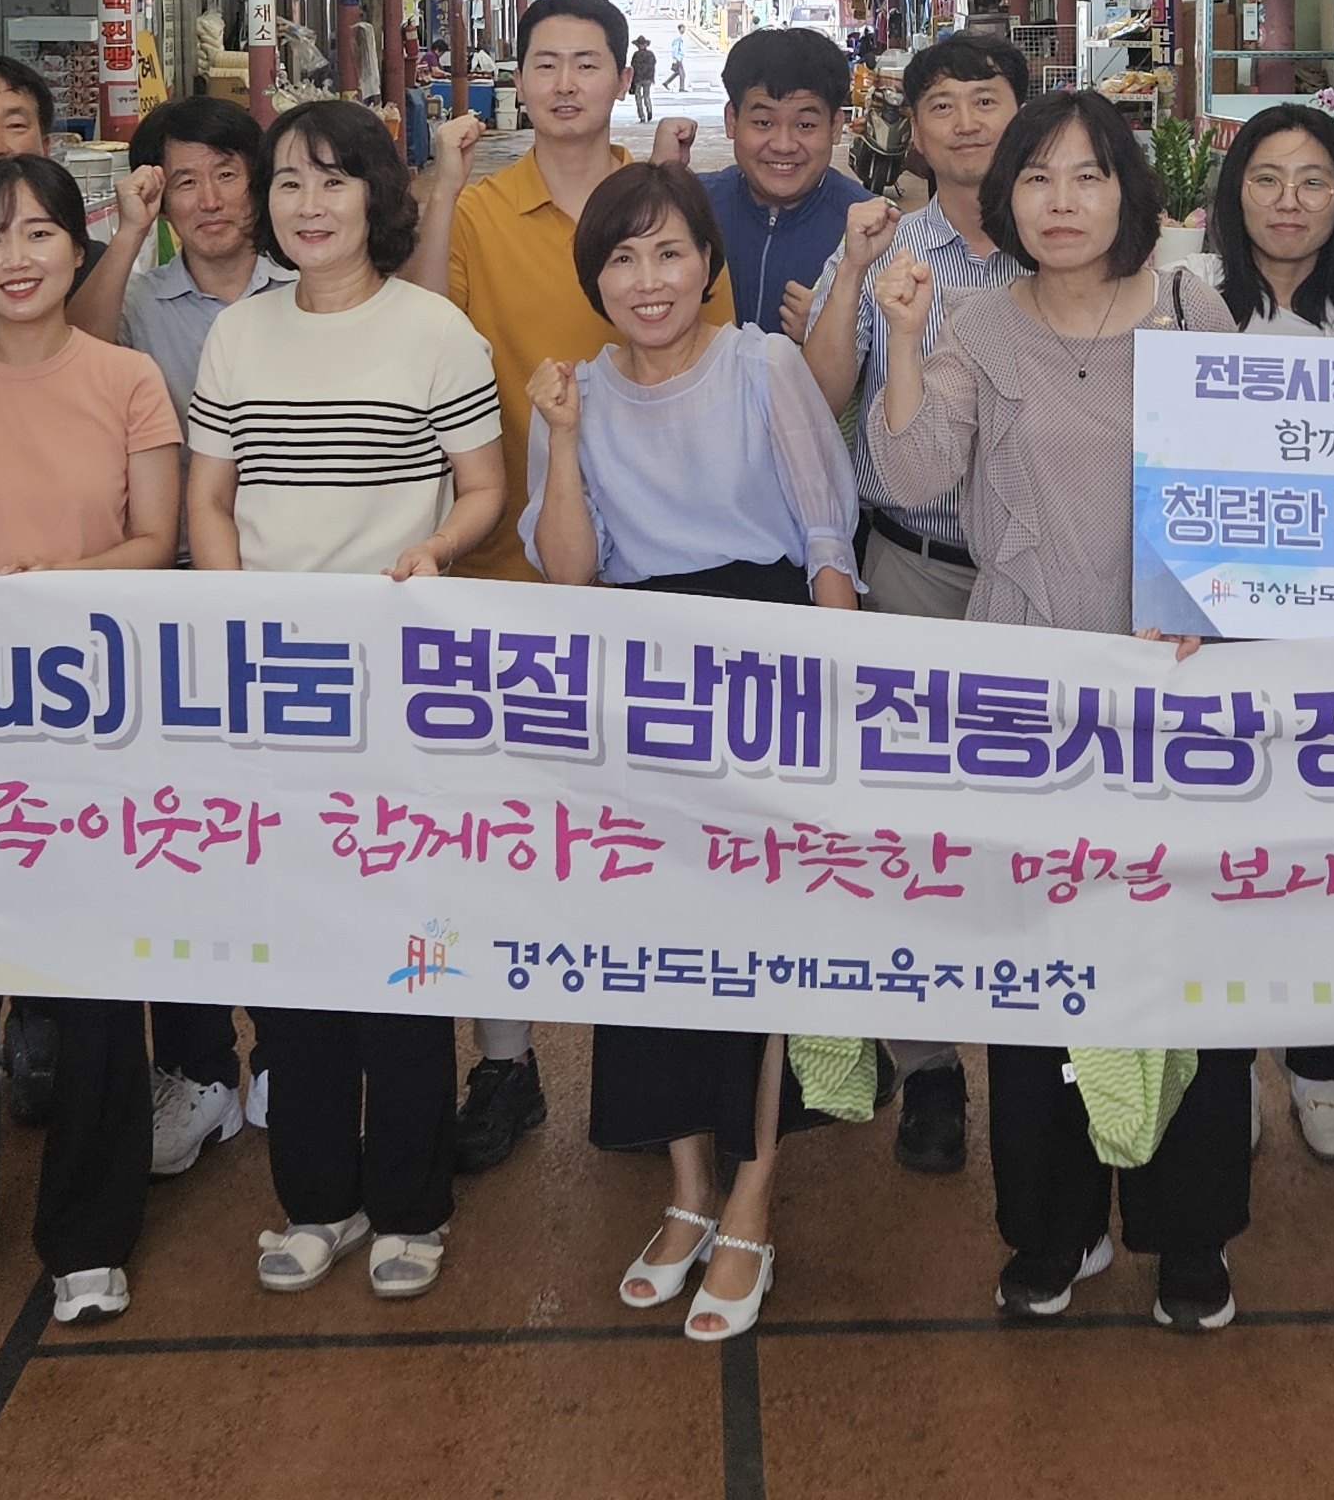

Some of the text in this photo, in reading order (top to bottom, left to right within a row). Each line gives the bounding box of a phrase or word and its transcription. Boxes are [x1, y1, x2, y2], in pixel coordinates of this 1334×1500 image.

[101, 20, 135, 71] 찐빵
[253, 3, 272, 41] 채소
[1163, 483, 1326, 547] 청렴한
[160, 613, 352, 739] 나눔
[402, 625, 592, 752] 명절
[625, 638, 822, 769] 남해
[855, 664, 1265, 787] 전통시장
[320, 789, 666, 886] 함께하는
[703, 822, 975, 901] 따뜻한
[1010, 838, 1175, 904] 명절
[493, 939, 1097, 1017] 경상남도남해교육지원청
